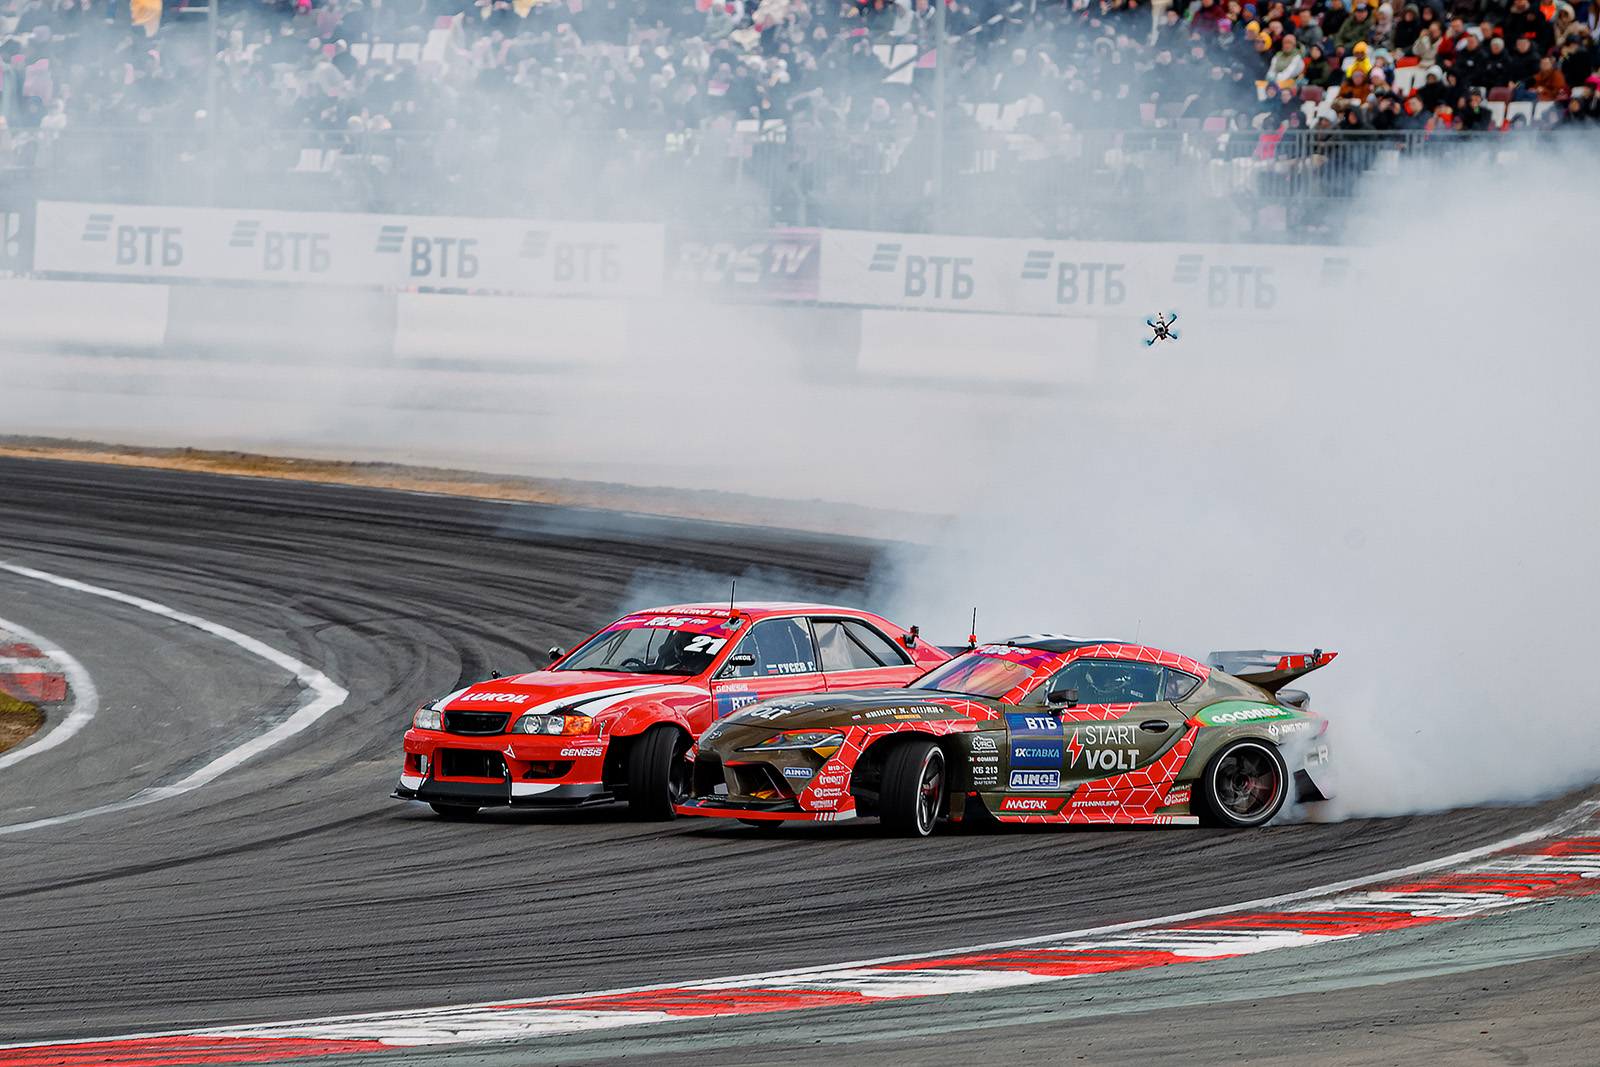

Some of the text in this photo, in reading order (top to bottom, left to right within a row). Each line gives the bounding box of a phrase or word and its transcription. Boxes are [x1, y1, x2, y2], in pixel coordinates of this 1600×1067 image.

[116, 225, 184, 267] ВТБ
[262, 230, 331, 272] ВТБ
[410, 236, 479, 278] ВТБ
[554, 241, 622, 283] ВТБ
[768, 242, 820, 274] TV
[904, 255, 974, 299] ВТБ
[1056, 262, 1126, 306] ВТБ
[1207, 265, 1278, 309] ВТБ
[683, 635, 729, 656] 21
[777, 662, 807, 674] ГУСЕВ
[460, 692, 530, 704] LUKOIL
[1025, 717, 1058, 730] ВТБ
[1211, 707, 1287, 724] GOODRIDE
[1085, 725, 1140, 745] START
[560, 748, 603, 757] GENESIS
[1085, 749, 1140, 770] VOLT
[985, 766, 998, 775] 213
[1012, 773, 1057, 786] AIMOL
[1006, 800, 1047, 809] МАСТАК
